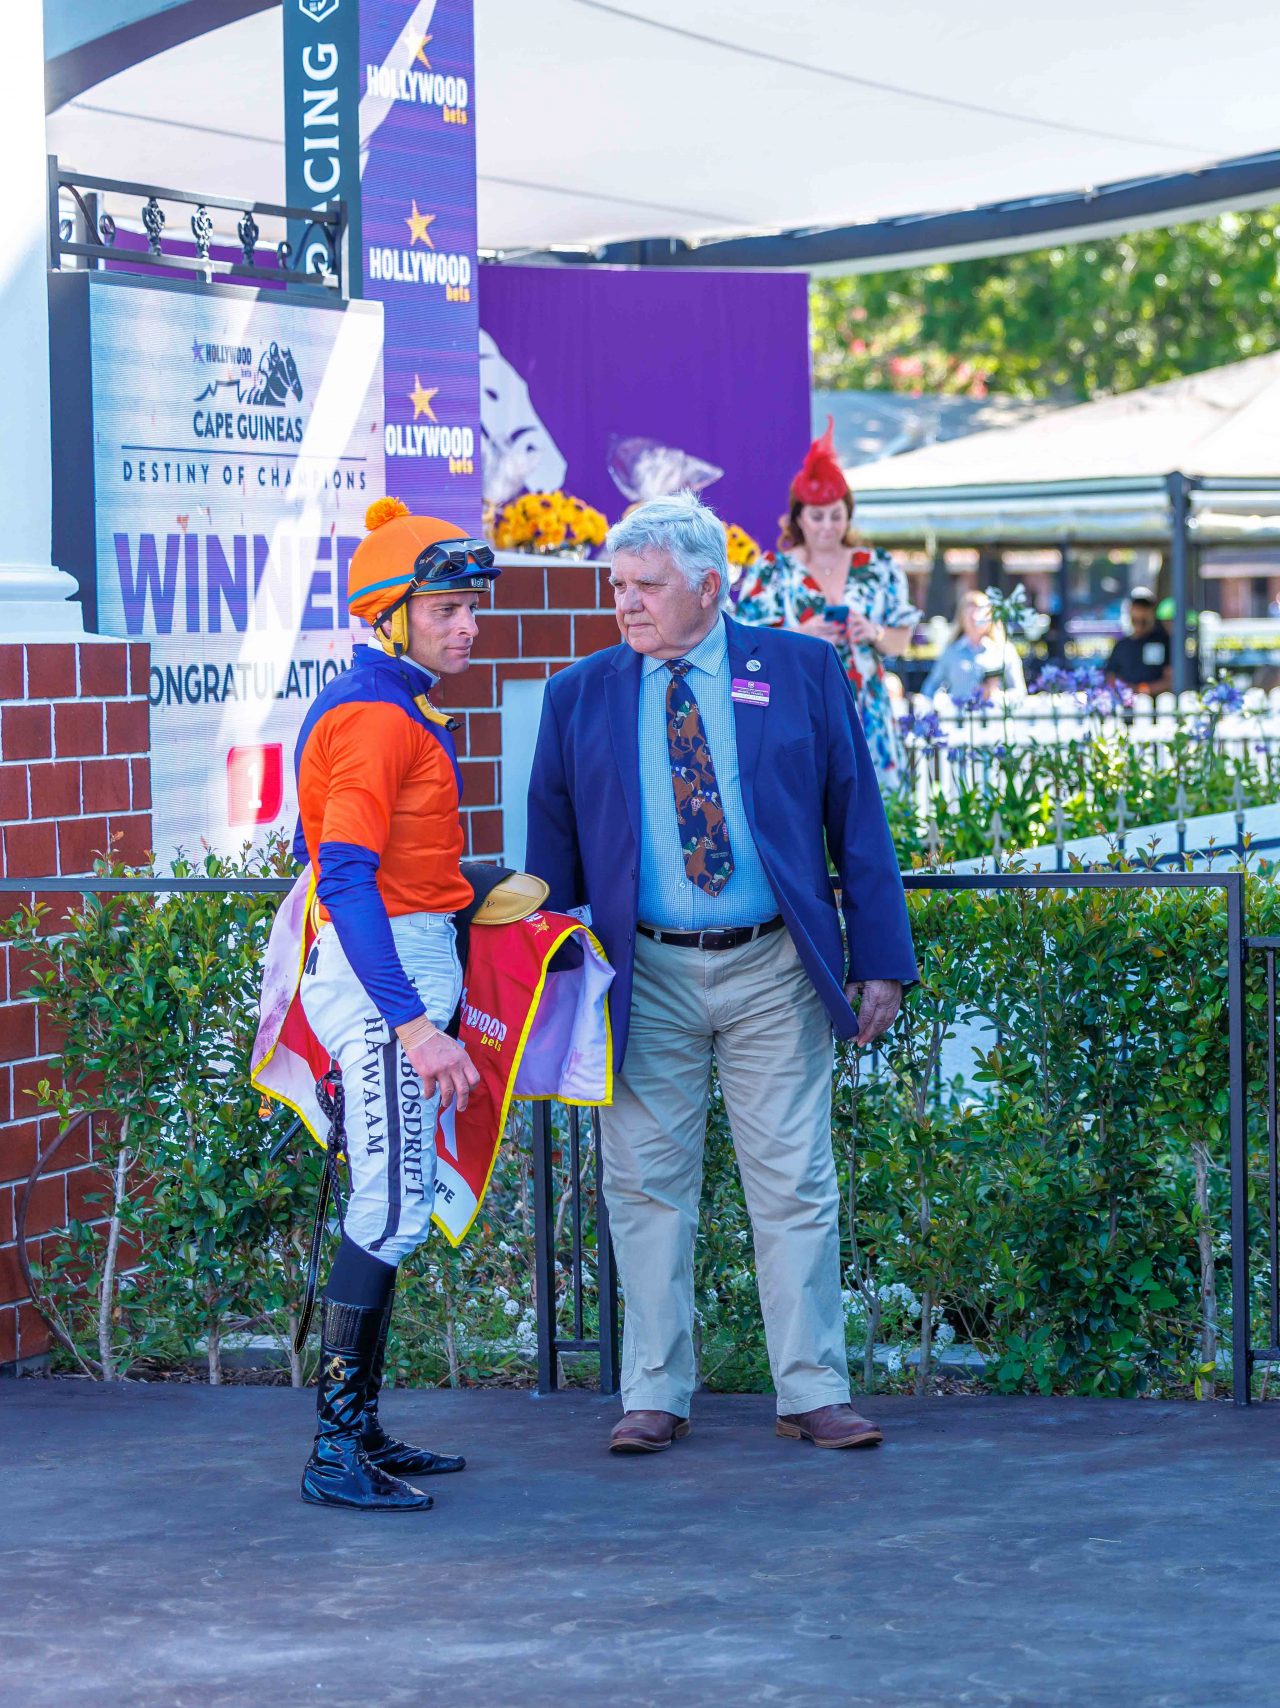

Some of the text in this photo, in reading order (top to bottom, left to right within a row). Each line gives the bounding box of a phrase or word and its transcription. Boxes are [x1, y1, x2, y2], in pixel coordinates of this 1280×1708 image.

[366, 64, 468, 108] HOLLYWOOD
[369, 247, 471, 286] HOLLYWOOD
[193, 410, 303, 443] CAPE GUINEAS
[385, 424, 474, 458] OLLYWOOD
[123, 461, 366, 490] DESTINY OF CHAIONS
[480, 1033, 502, 1052] bets
[362, 1016, 388, 1156] HAWAAM
